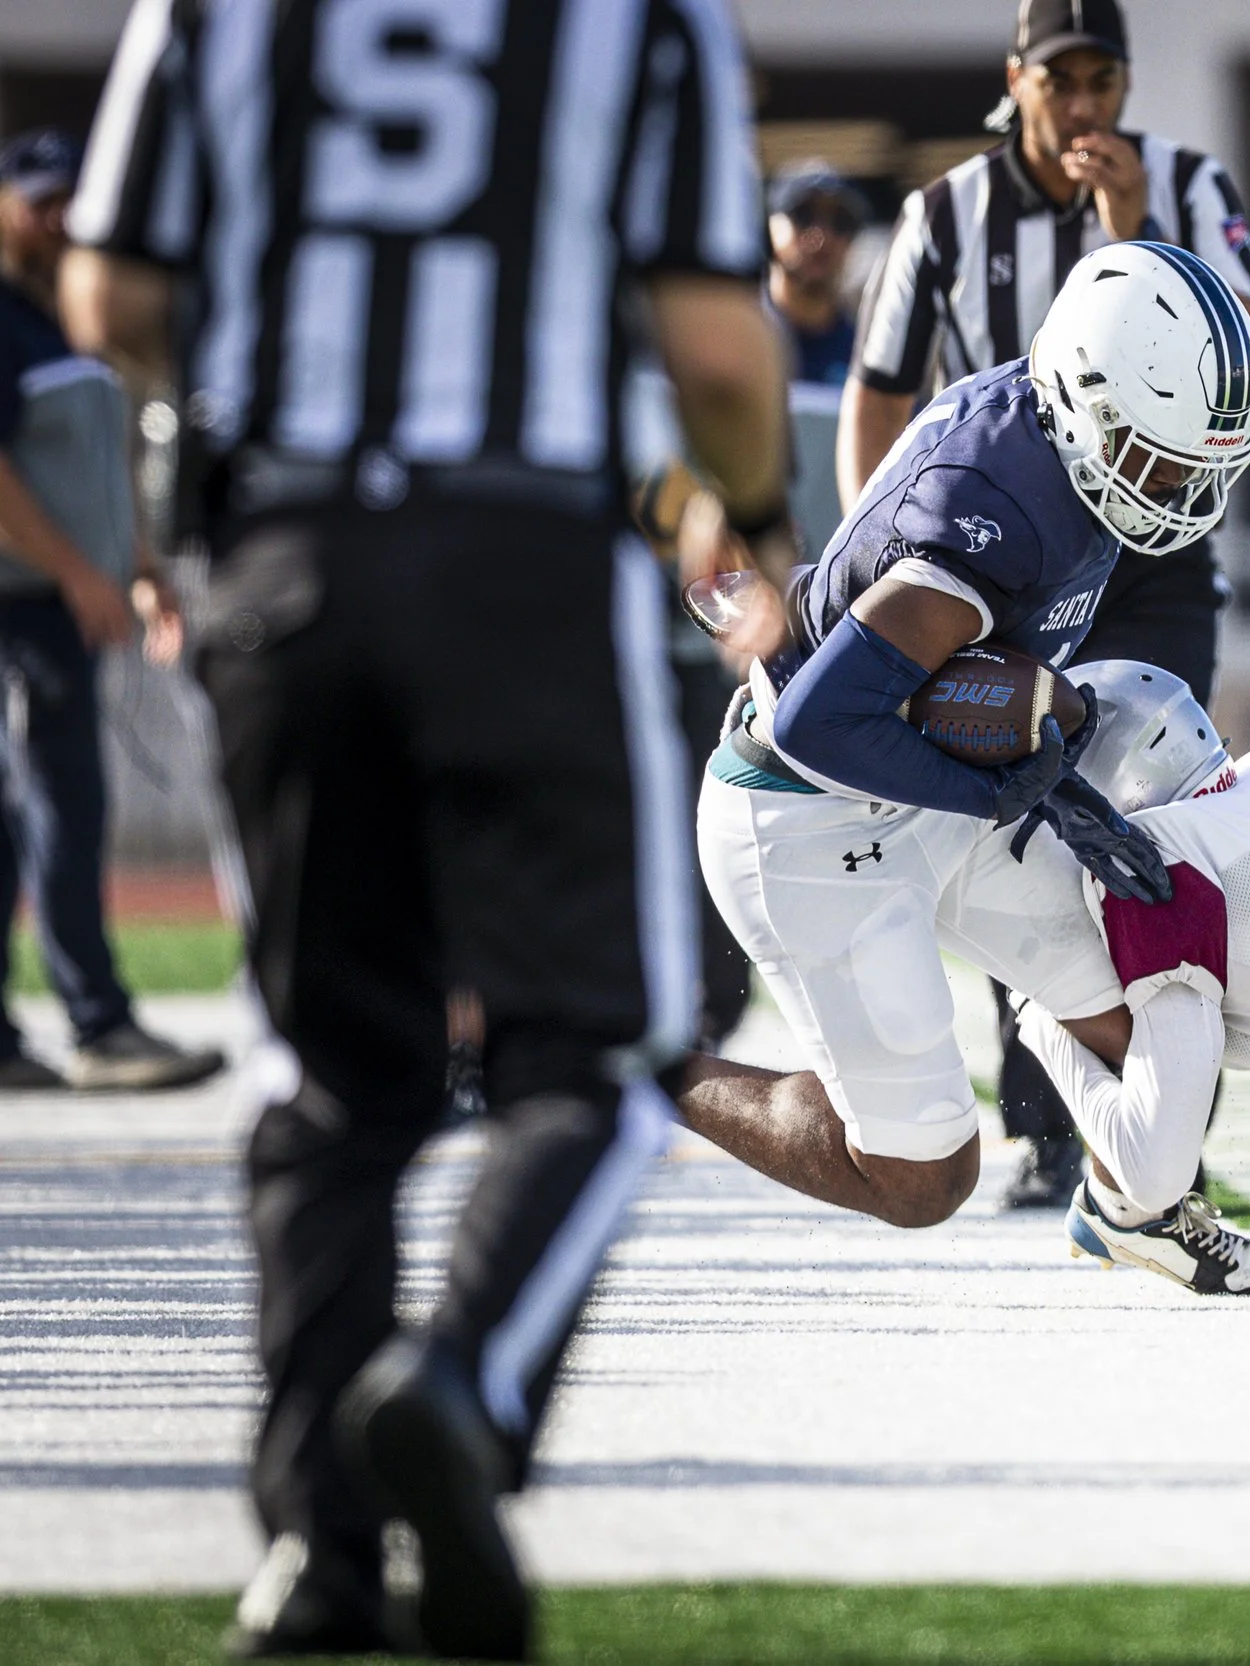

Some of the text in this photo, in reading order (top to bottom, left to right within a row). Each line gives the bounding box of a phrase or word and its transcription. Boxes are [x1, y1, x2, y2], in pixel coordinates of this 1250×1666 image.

[304, 0, 506, 231] S
[1204, 434, 1245, 446] Riddell
[1039, 589, 1094, 632] SANTA
[976, 652, 1006, 664] TEAM
[928, 681, 1015, 707] SMC
